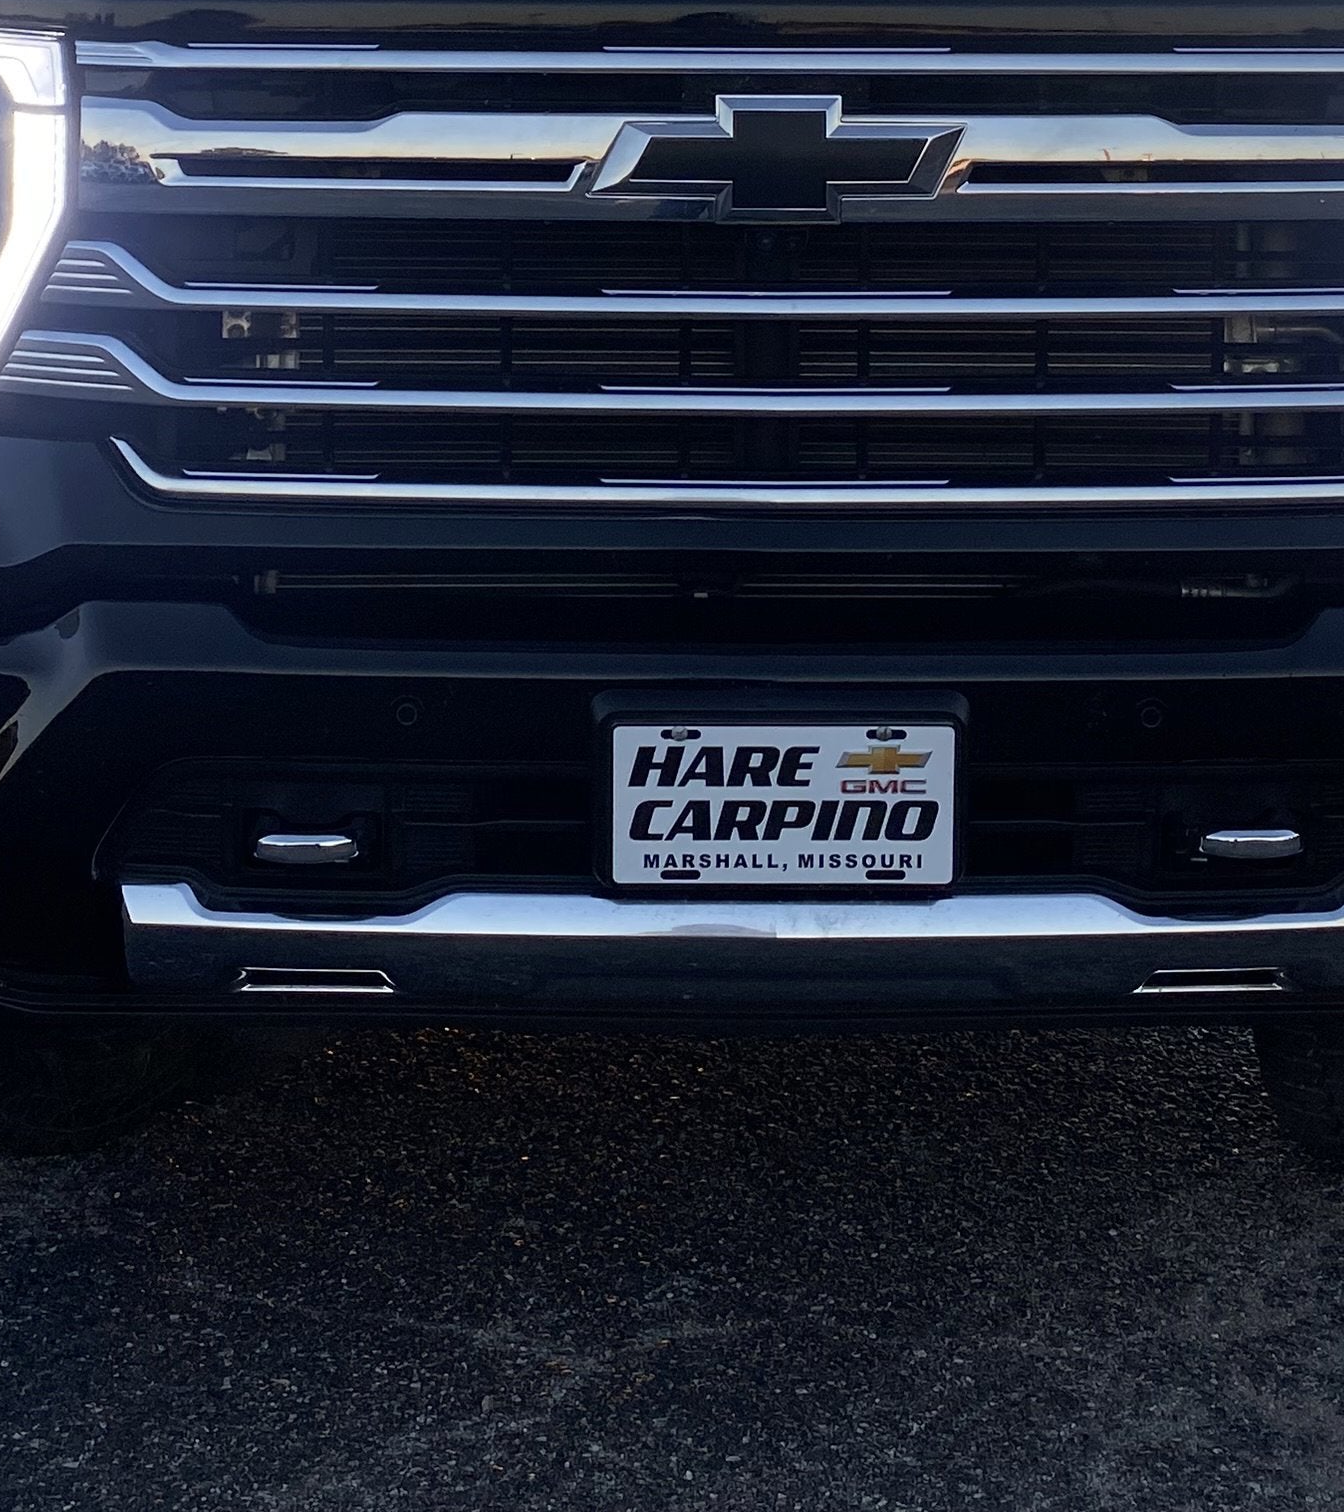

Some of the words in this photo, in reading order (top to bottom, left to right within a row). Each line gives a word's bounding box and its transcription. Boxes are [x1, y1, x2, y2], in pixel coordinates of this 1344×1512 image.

[628, 745, 820, 787] HARE
[840, 779, 927, 794] GMC
[629, 800, 939, 841] CARPINO
[643, 853, 788, 871] MARSHALL,
[797, 853, 923, 869] MISSOURI
